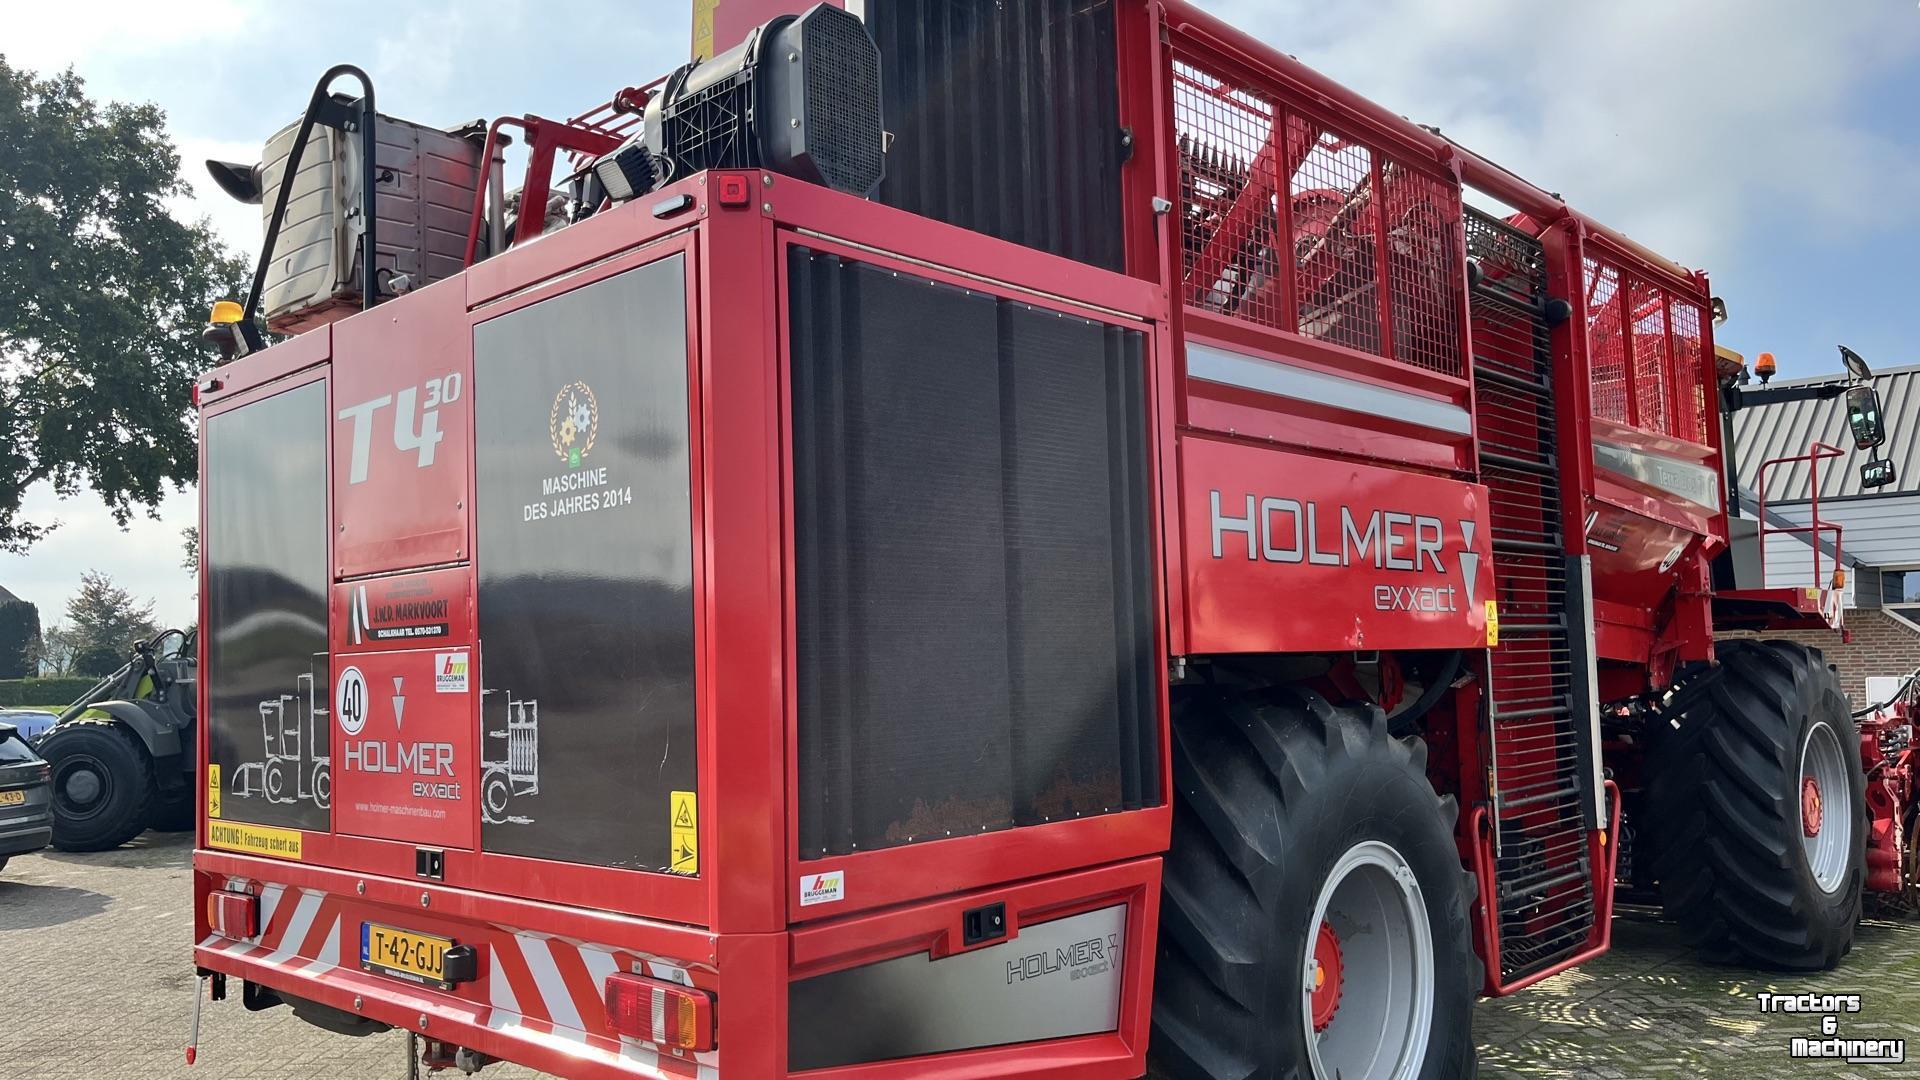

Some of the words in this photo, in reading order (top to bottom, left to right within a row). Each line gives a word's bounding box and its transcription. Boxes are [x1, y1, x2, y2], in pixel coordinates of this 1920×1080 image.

[543, 467, 607, 495] MASCHINE
[524, 502, 547, 521] DES
[550, 493, 600, 517] JAHRES
[603, 486, 632, 508] 2014
[1209, 489, 1446, 574] HOLMER
[395, 599, 449, 622] MARKVOORT
[1374, 583, 1457, 612] exxact
[342, 679, 362, 722] 40
[344, 740, 456, 778] HOLMER
[412, 781, 462, 801] exxact
[355, 801, 447, 820] www.holmer-maschinenbau.com
[244, 832, 268, 850] Fahrzeug
[269, 836, 287, 853] schert
[288, 840, 299, 853] aus
[376, 932, 443, 974] T-42-GJJ
[1007, 937, 1105, 984] HOLMER
